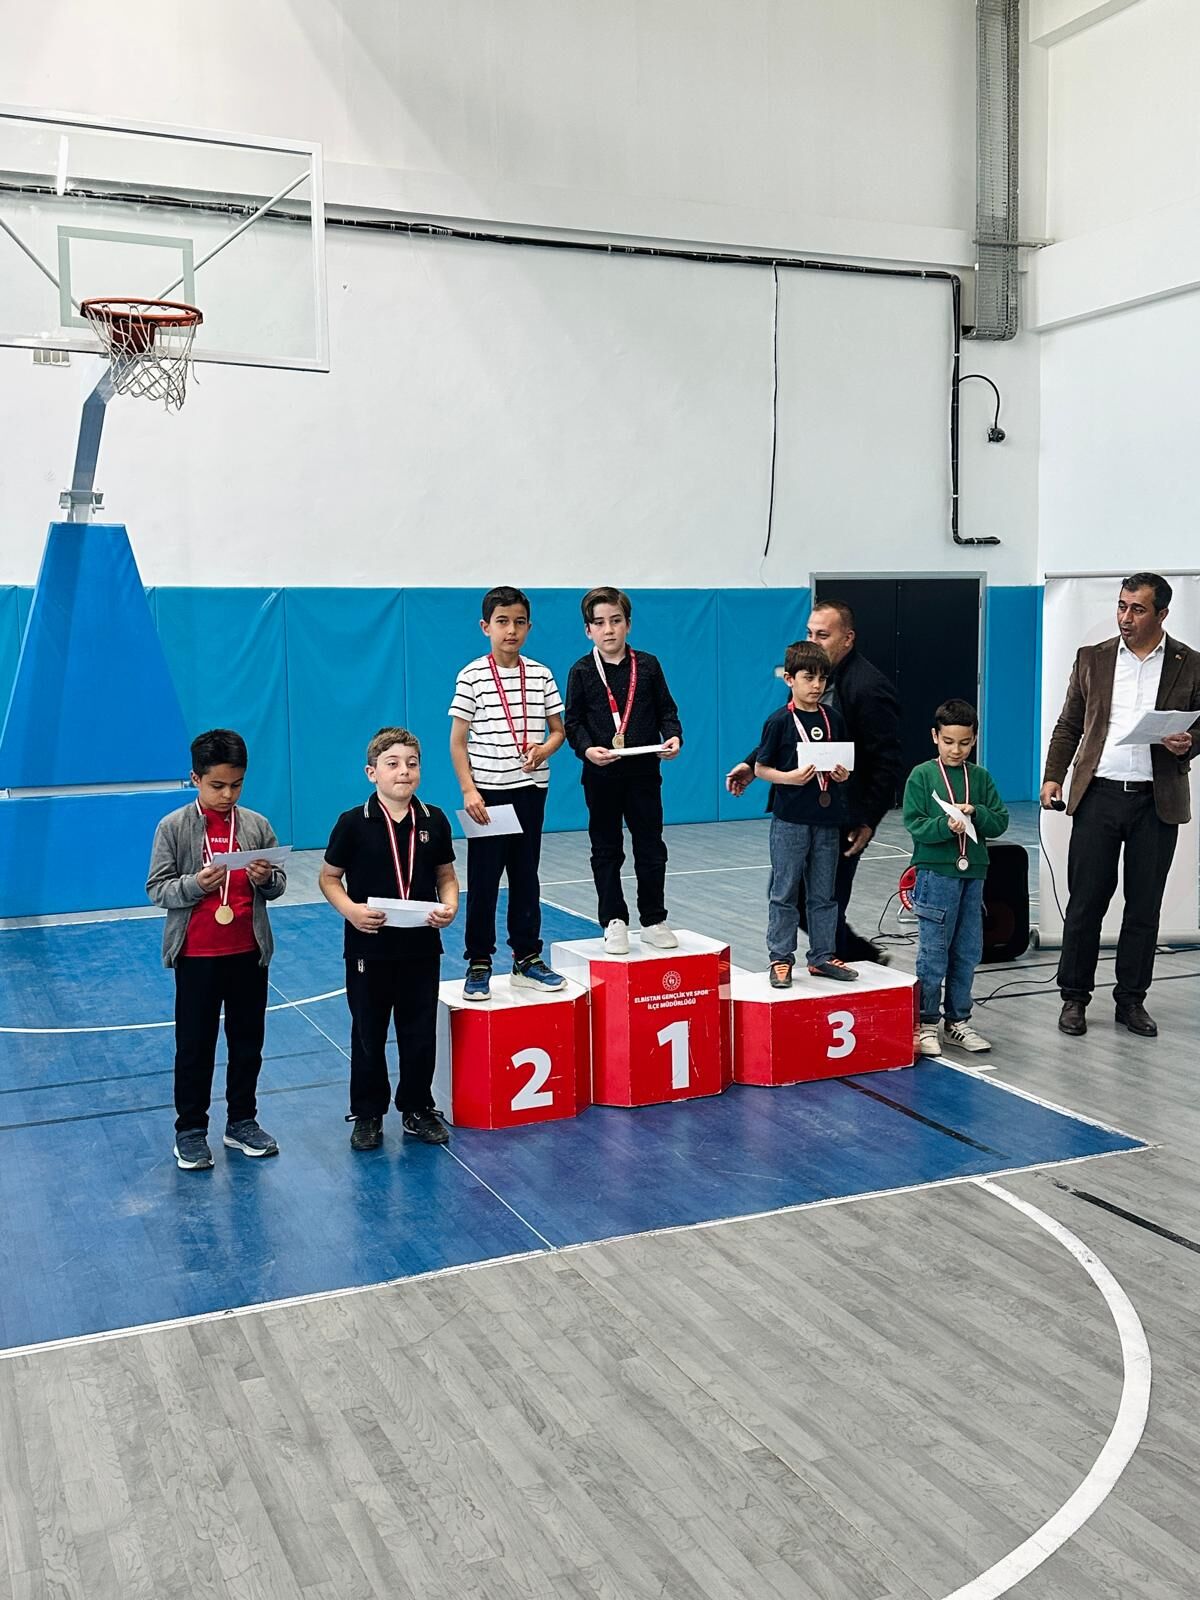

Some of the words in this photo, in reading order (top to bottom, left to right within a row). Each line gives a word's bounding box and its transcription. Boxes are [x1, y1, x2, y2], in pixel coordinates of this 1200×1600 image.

[634, 994, 661, 1003] ELBİSTAN
[661, 991, 686, 1000] GENÇLİK
[694, 989, 709, 997] SPOR
[648, 1002, 660, 1010] İLÇE
[660, 998, 697, 1008] MÜDÜRLÜĞÜ
[657, 1020, 690, 1090] 1
[827, 1010, 857, 1059] 3
[510, 1047, 553, 1111] 2
